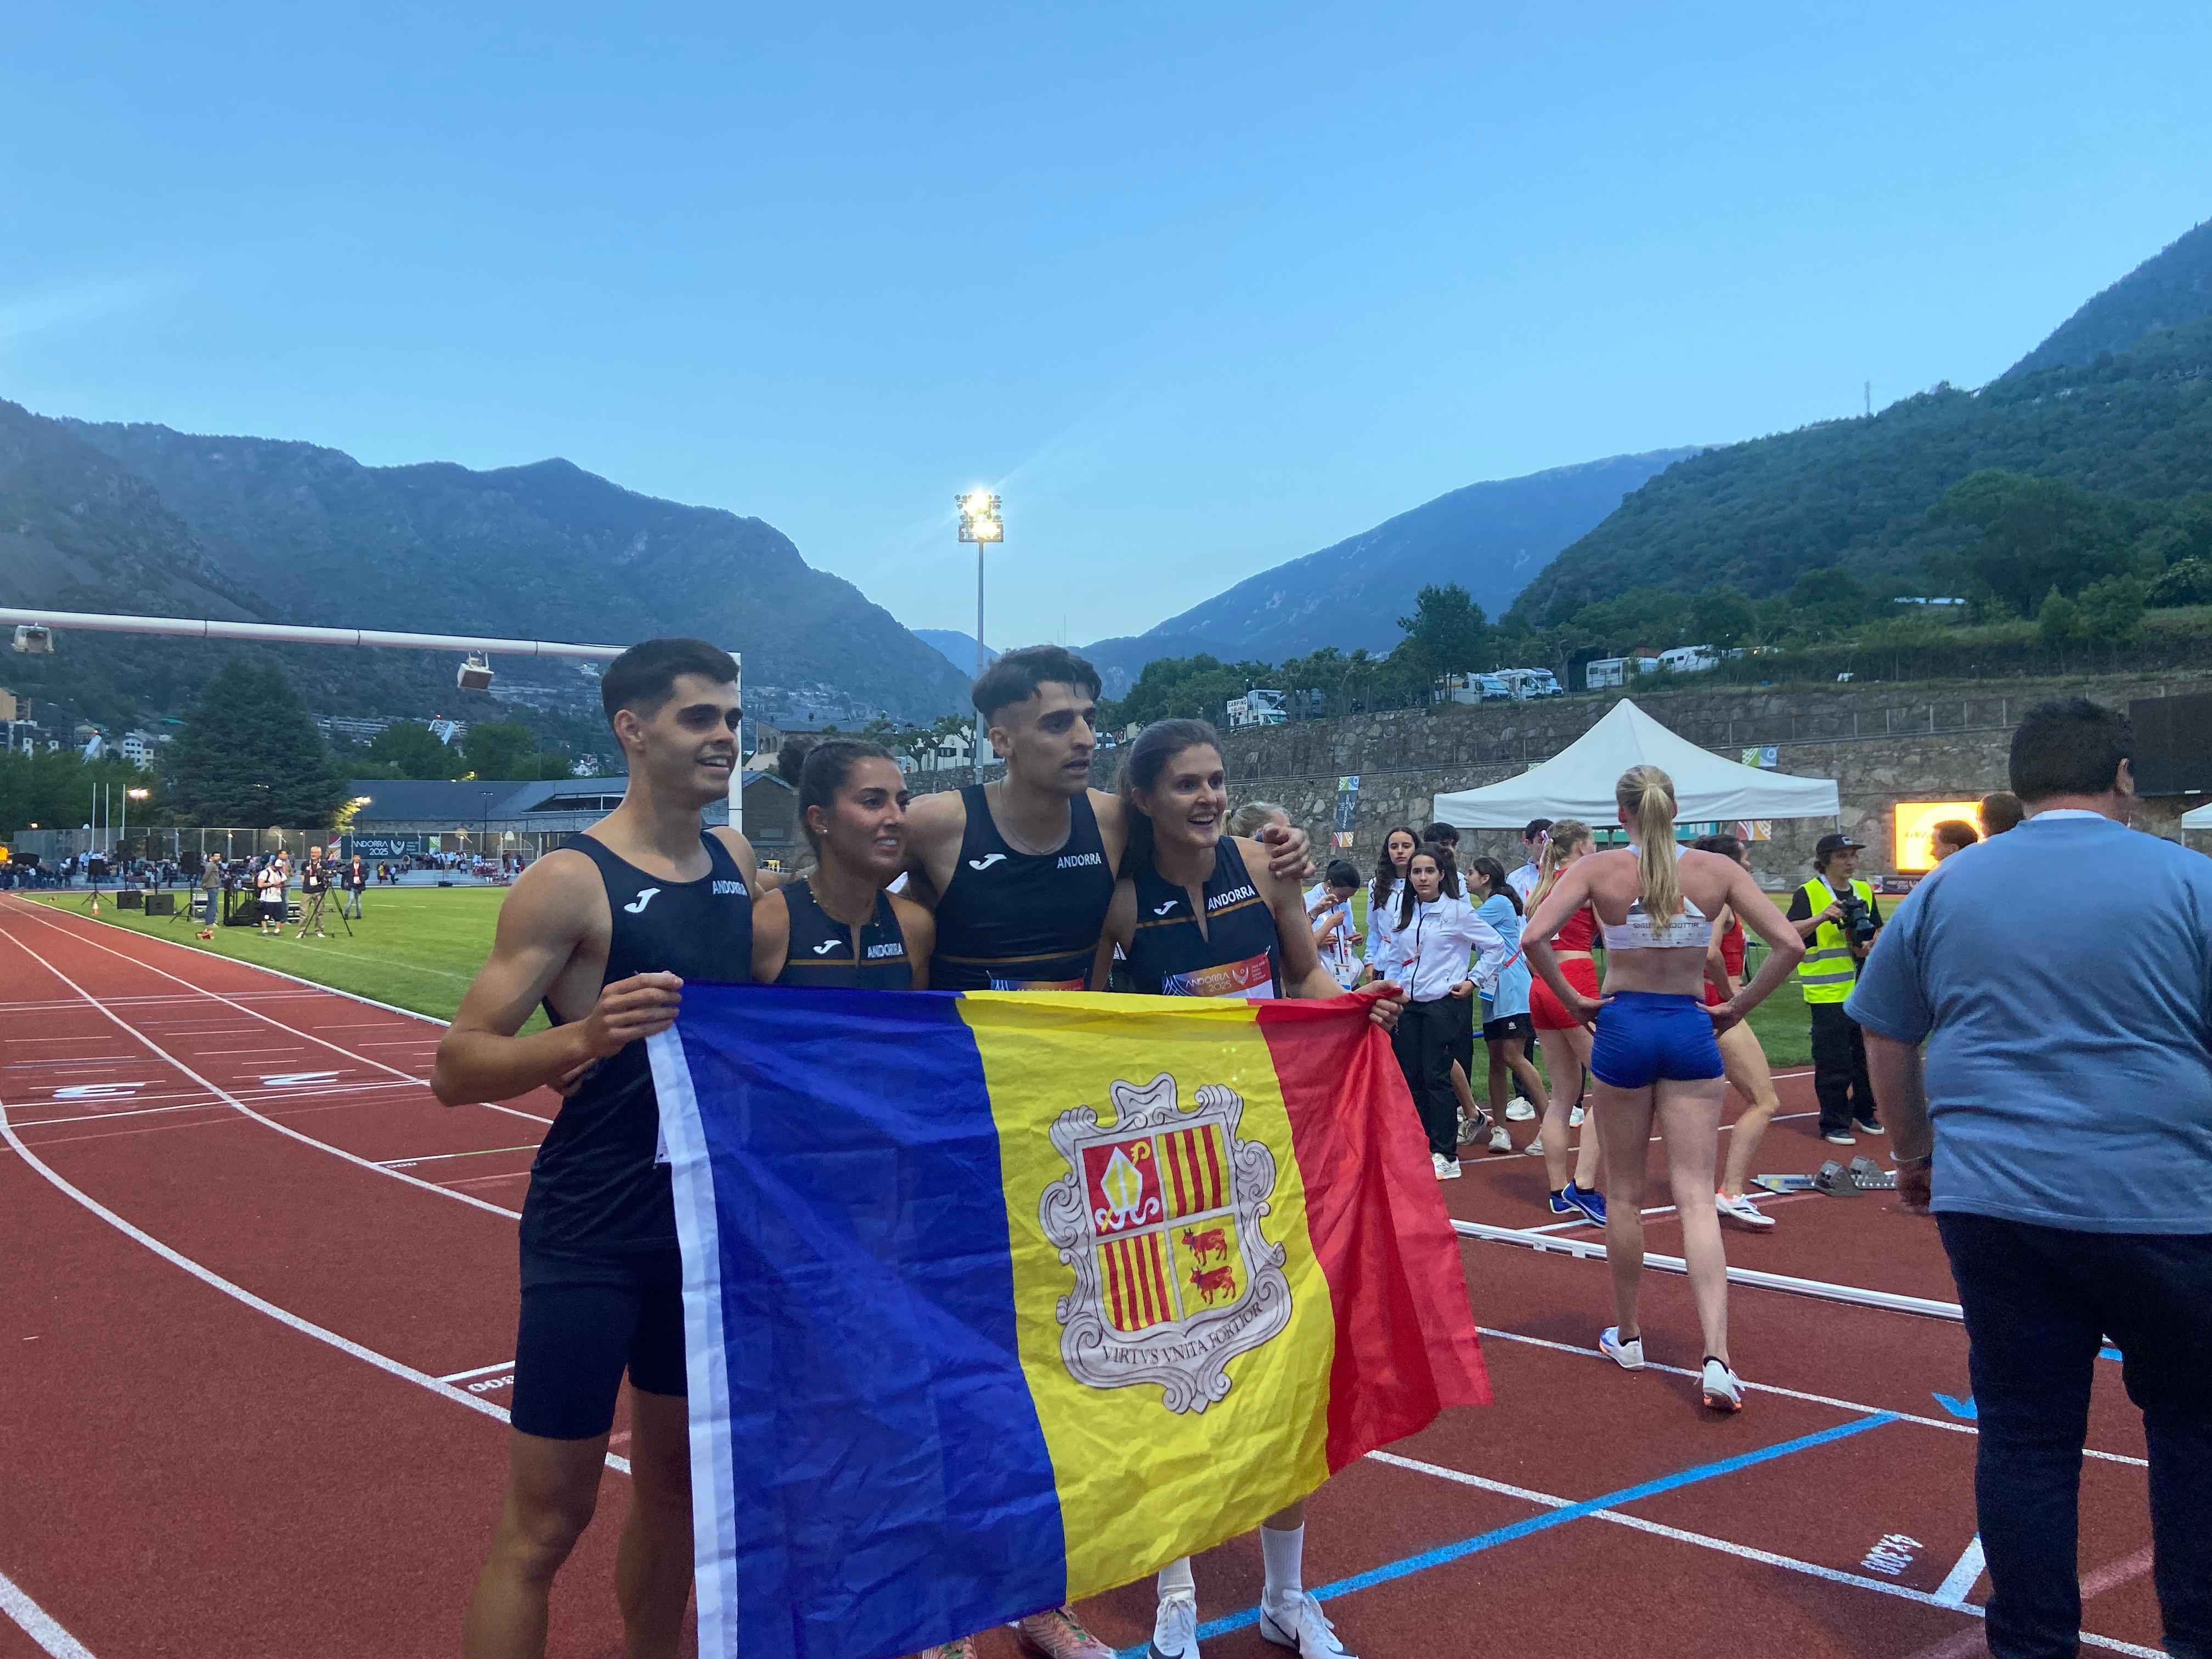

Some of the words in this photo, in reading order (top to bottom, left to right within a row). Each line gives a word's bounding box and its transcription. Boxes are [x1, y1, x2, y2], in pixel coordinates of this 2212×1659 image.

[1228, 699, 1247, 707] CAMPING
[1057, 853, 1102, 868] ANDORRA
[713, 880, 747, 896] ANDORRA
[1208, 884, 1256, 910] ANDORRA
[867, 943, 904, 958] ANDORRA
[1186, 972, 1230, 988] ANDORRA
[1209, 980, 1232, 992] 2025
[1103, 1346, 1158, 1364] VIRTVS
[1163, 1339, 1208, 1363] VNITA
[1207, 1302, 1262, 1348] FORTIOR
